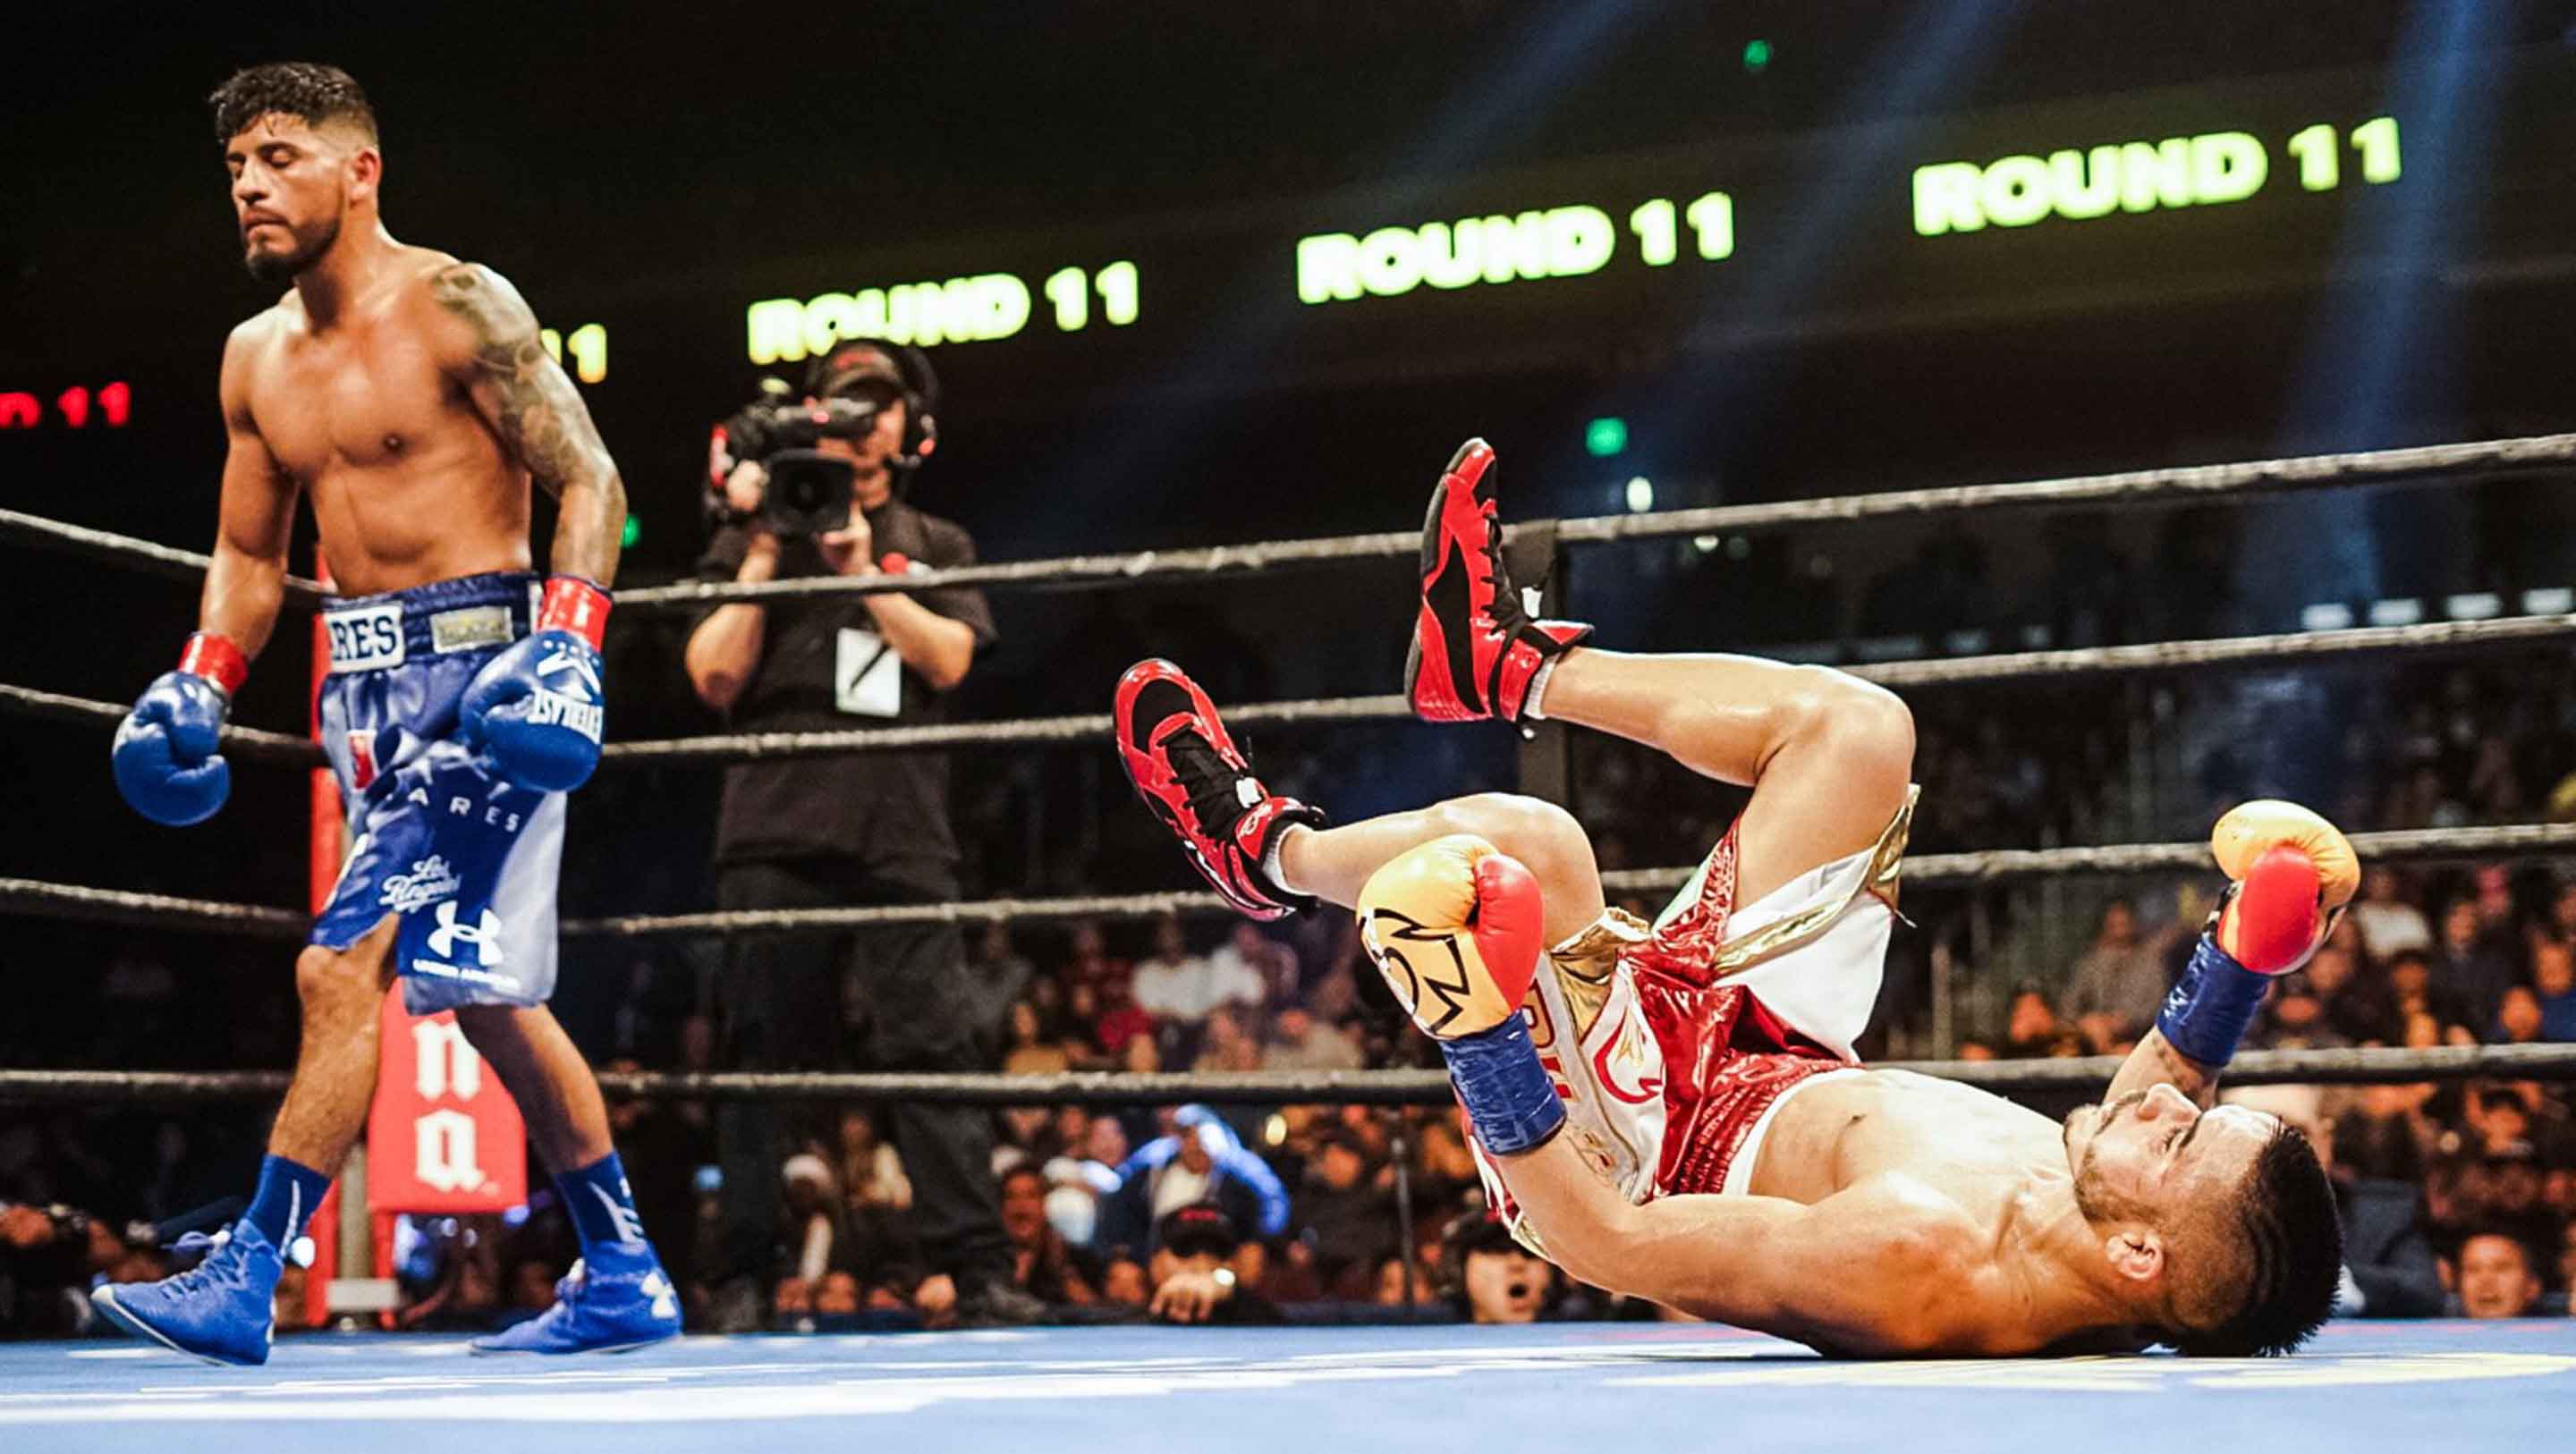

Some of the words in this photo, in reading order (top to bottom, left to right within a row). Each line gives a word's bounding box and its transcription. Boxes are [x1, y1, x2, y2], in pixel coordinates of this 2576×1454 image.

[1912, 131, 2269, 236] ROUND
[2287, 117, 2402, 191] 11
[1296, 205, 1616, 305] ROUND
[1629, 191, 1734, 266] 11
[747, 272, 1032, 365] ROUND
[1044, 260, 1139, 332] 11
[57, 381, 131, 427] 11
